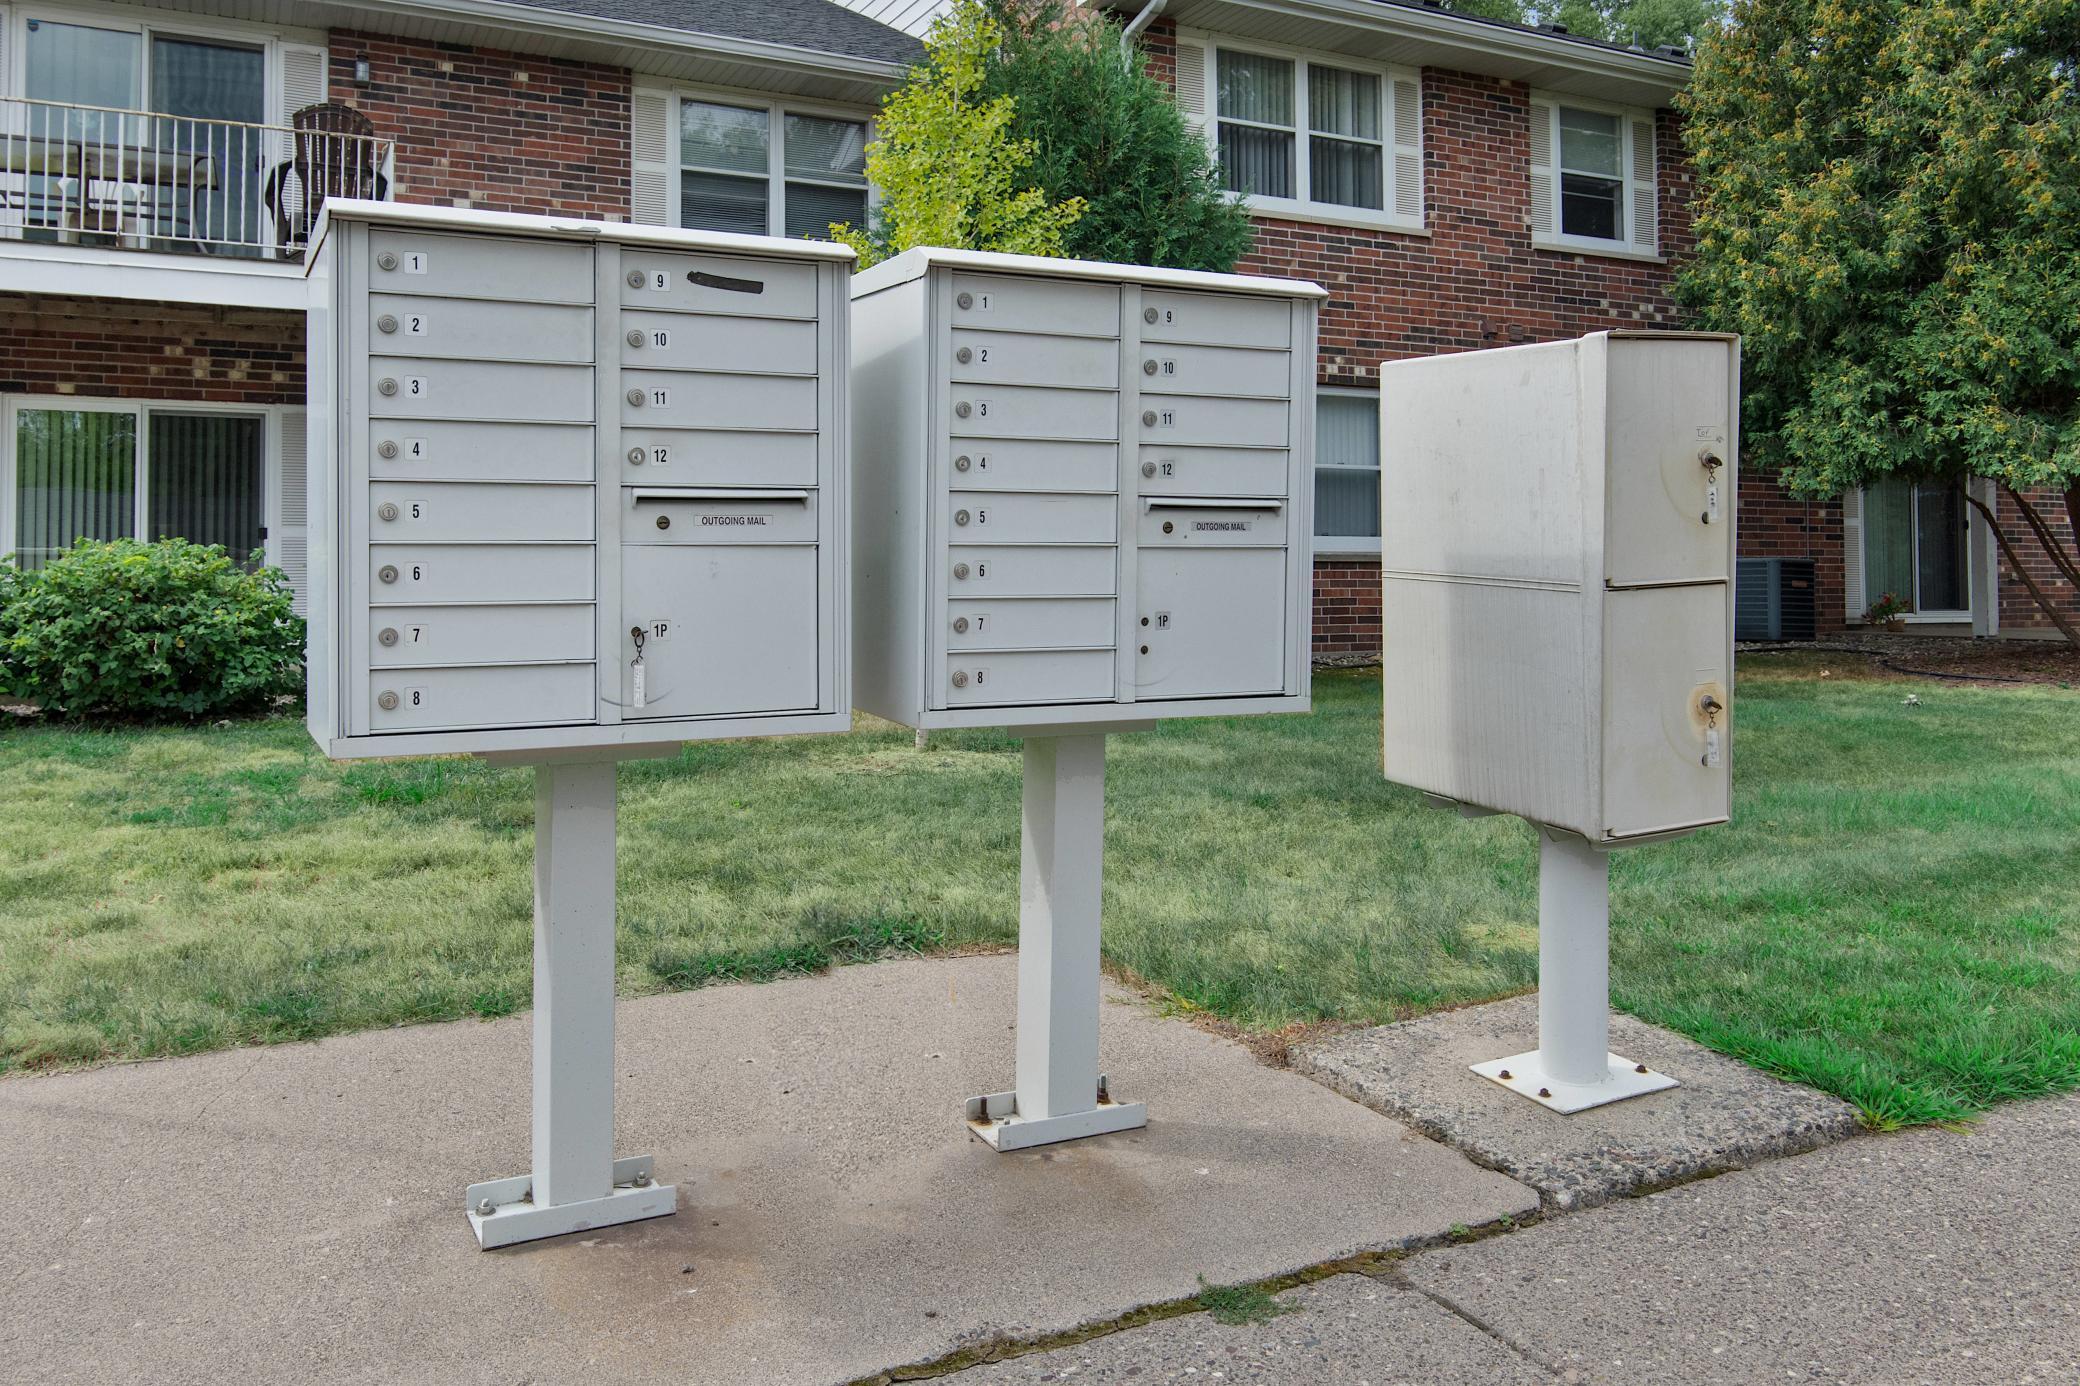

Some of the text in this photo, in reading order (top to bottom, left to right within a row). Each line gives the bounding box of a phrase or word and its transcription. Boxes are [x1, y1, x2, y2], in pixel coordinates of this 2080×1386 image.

[412, 255, 418, 271] 1
[657, 274, 664, 288] 9
[982, 295, 988, 309] 1
[1166, 310, 1172, 324] 9
[412, 317, 420, 333] 2
[653, 332, 667, 347] 10
[981, 349, 988, 363] 2
[1163, 361, 1174, 375] 10
[411, 379, 420, 395] 3
[653, 390, 666, 405] 11
[980, 403, 987, 417] 3
[1162, 412, 1172, 425] 11
[412, 441, 420, 457] 4
[653, 448, 667, 463] 12
[980, 456, 986, 470] 4
[1161, 463, 1172, 476] 12
[412, 503, 420, 519] 5
[979, 510, 986, 524] 5
[701, 516, 767, 526] OUTGOING MAIL
[1195, 522, 1247, 532] OUTGOING MAIL
[413, 566, 421, 581] 6
[979, 564, 985, 577] 6
[977, 617, 984, 631] 7
[1157, 614, 1169, 628] 1P
[412, 628, 421, 643] 7
[653, 623, 668, 638] 1P
[977, 671, 984, 684] 8
[412, 690, 421, 706] 8
